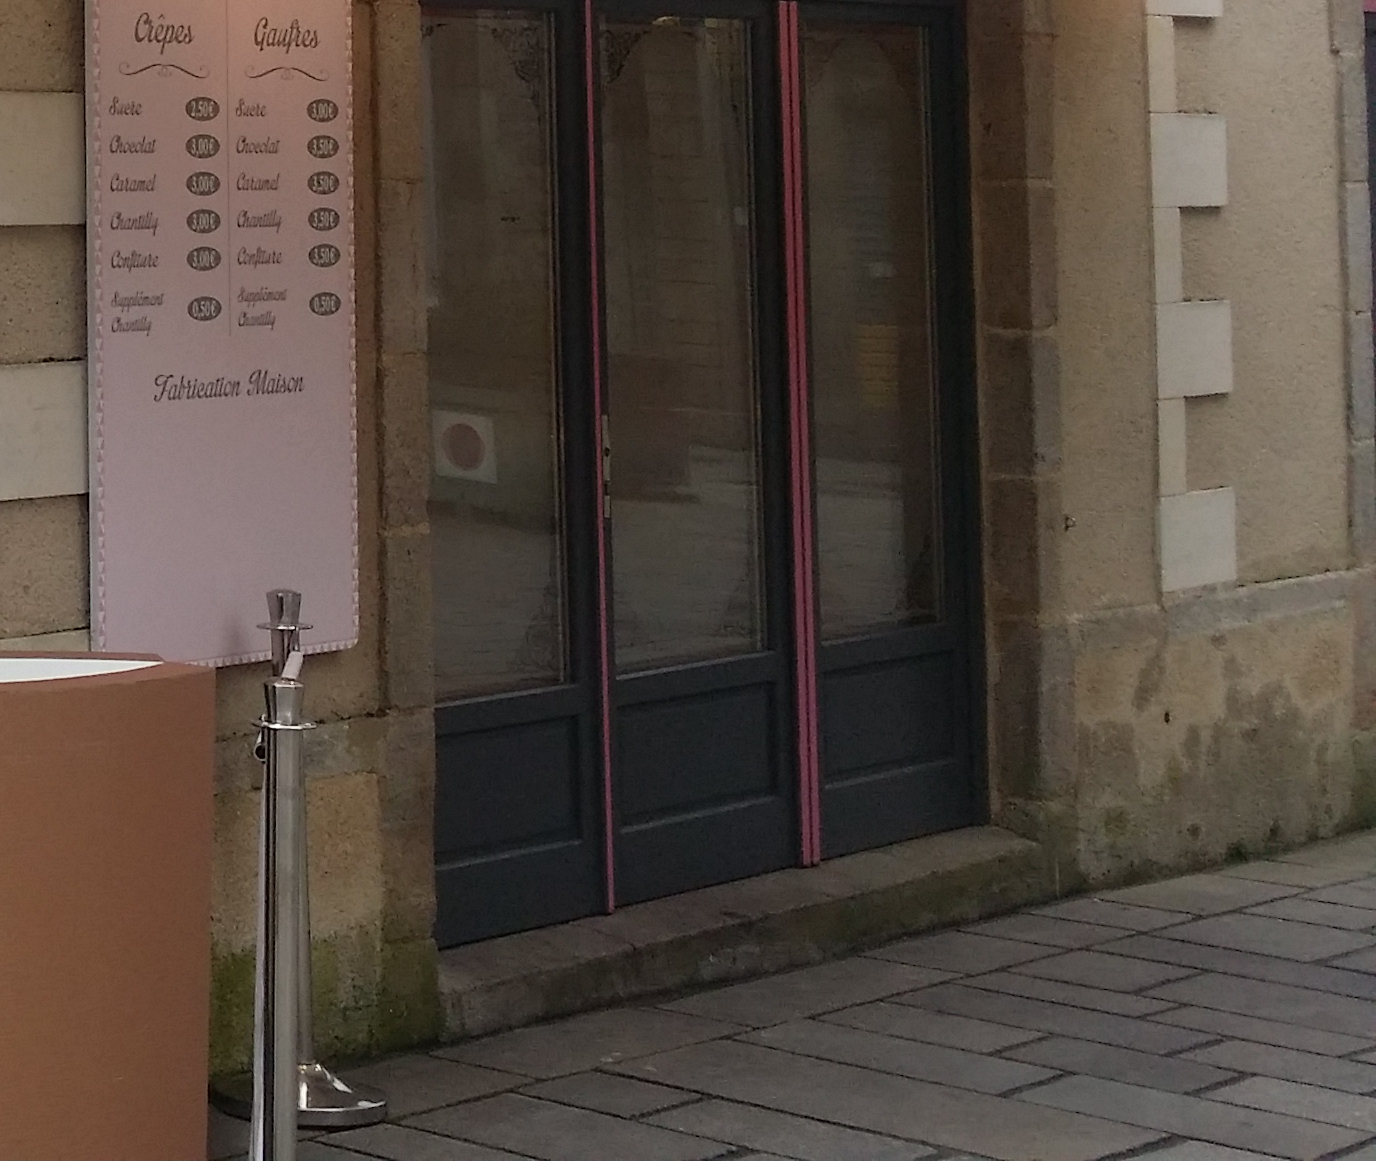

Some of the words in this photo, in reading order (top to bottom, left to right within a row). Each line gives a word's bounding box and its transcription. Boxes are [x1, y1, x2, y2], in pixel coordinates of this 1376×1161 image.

[134, 12, 195, 54] Crêpes
[253, 16, 321, 54] Gaufres
[109, 96, 142, 117] Sucre
[235, 98, 267, 118] Sucre
[109, 134, 156, 155] Chocolat
[236, 135, 280, 154] Chocolat
[110, 173, 156, 193] Caramel
[236, 172, 279, 191] Caramel
[110, 212, 159, 236] Chantilly
[237, 210, 283, 233] Chantilly
[110, 249, 159, 273] Confiture
[237, 246, 283, 267] Confiture
[153, 374, 241, 402] Fabrication
[247, 369, 305, 397] Maison
